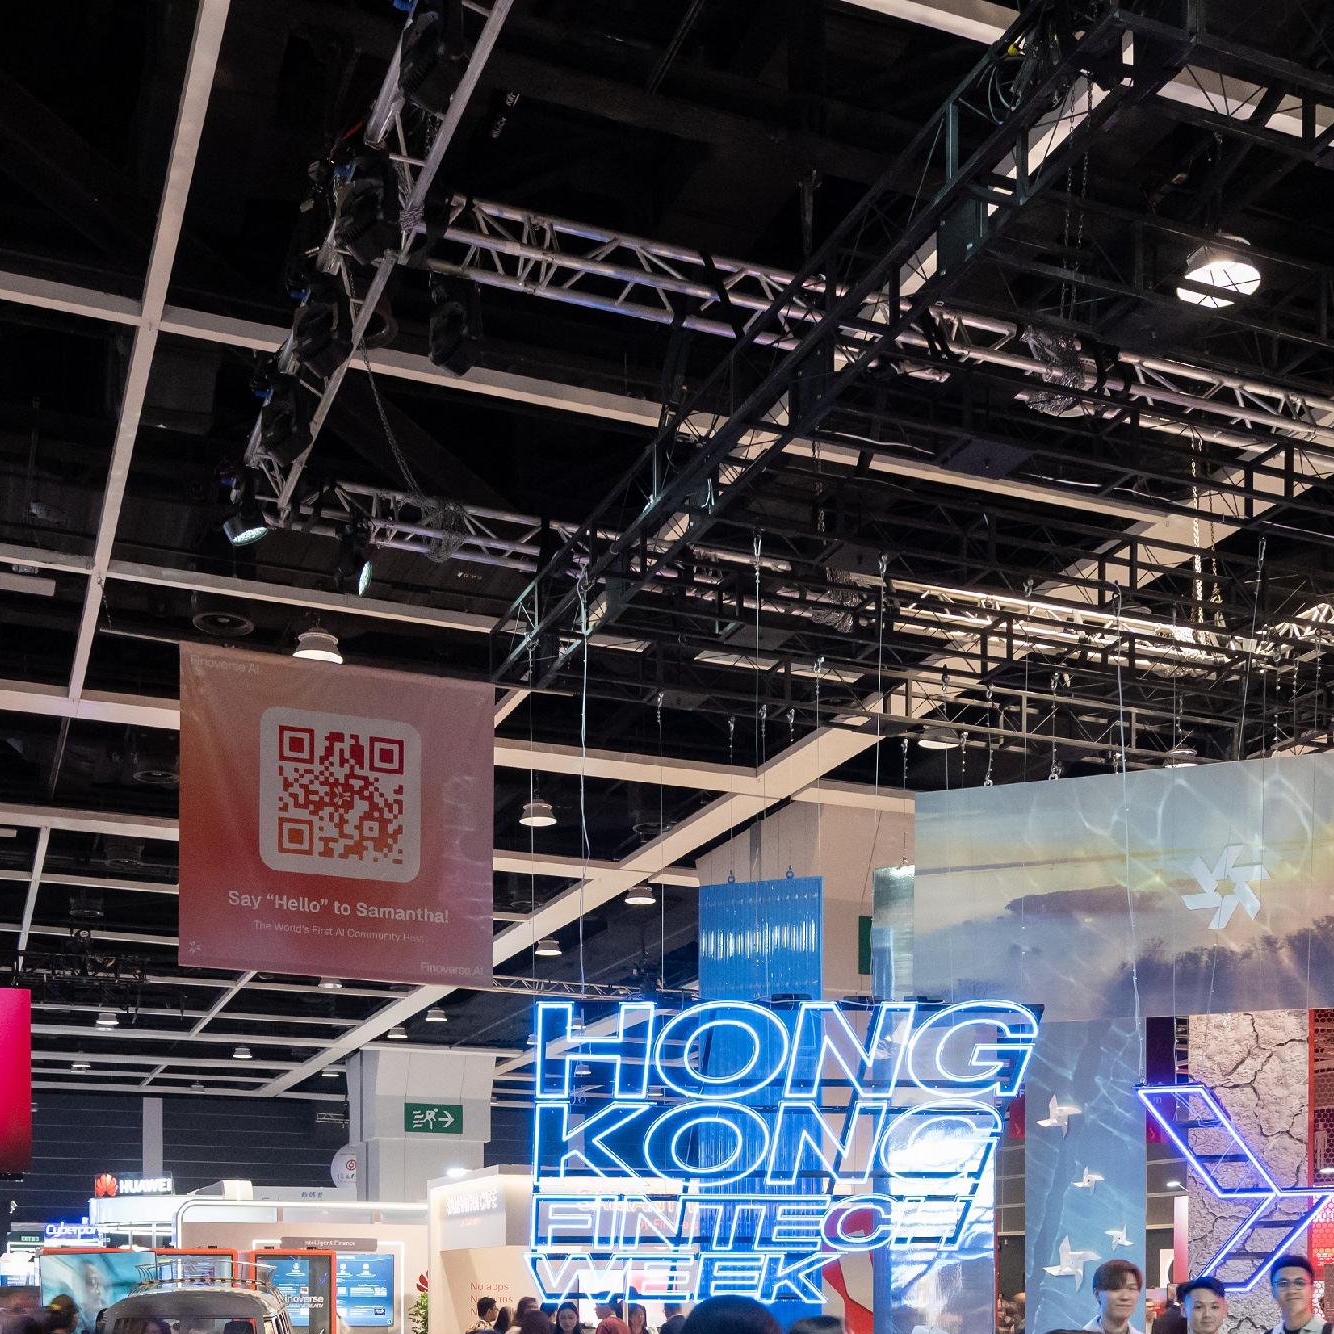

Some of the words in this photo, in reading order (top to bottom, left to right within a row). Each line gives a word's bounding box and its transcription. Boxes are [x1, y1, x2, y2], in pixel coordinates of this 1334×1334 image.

[190, 655, 246, 673] Finoverse
[228, 890, 262, 910] Say
[266, 894, 328, 913] “Hello”
[333, 900, 351, 916] to
[356, 902, 449, 924] Samantha!
[254, 919, 272, 930] The
[312, 924, 334, 936] First
[335, 927, 345, 937] AI
[347, 928, 402, 942] Community
[420, 961, 469, 975] Finoverse
[471, 966, 484, 976] AI
[533, 999, 1040, 1100] HONG
[532, 1099, 1004, 1187] KONG
[119, 1178, 172, 1194] HUAWEI
[529, 1192, 974, 1252] FINTECH
[523, 1252, 839, 1305] WEEK
[284, 1295, 324, 1304] inoverse
